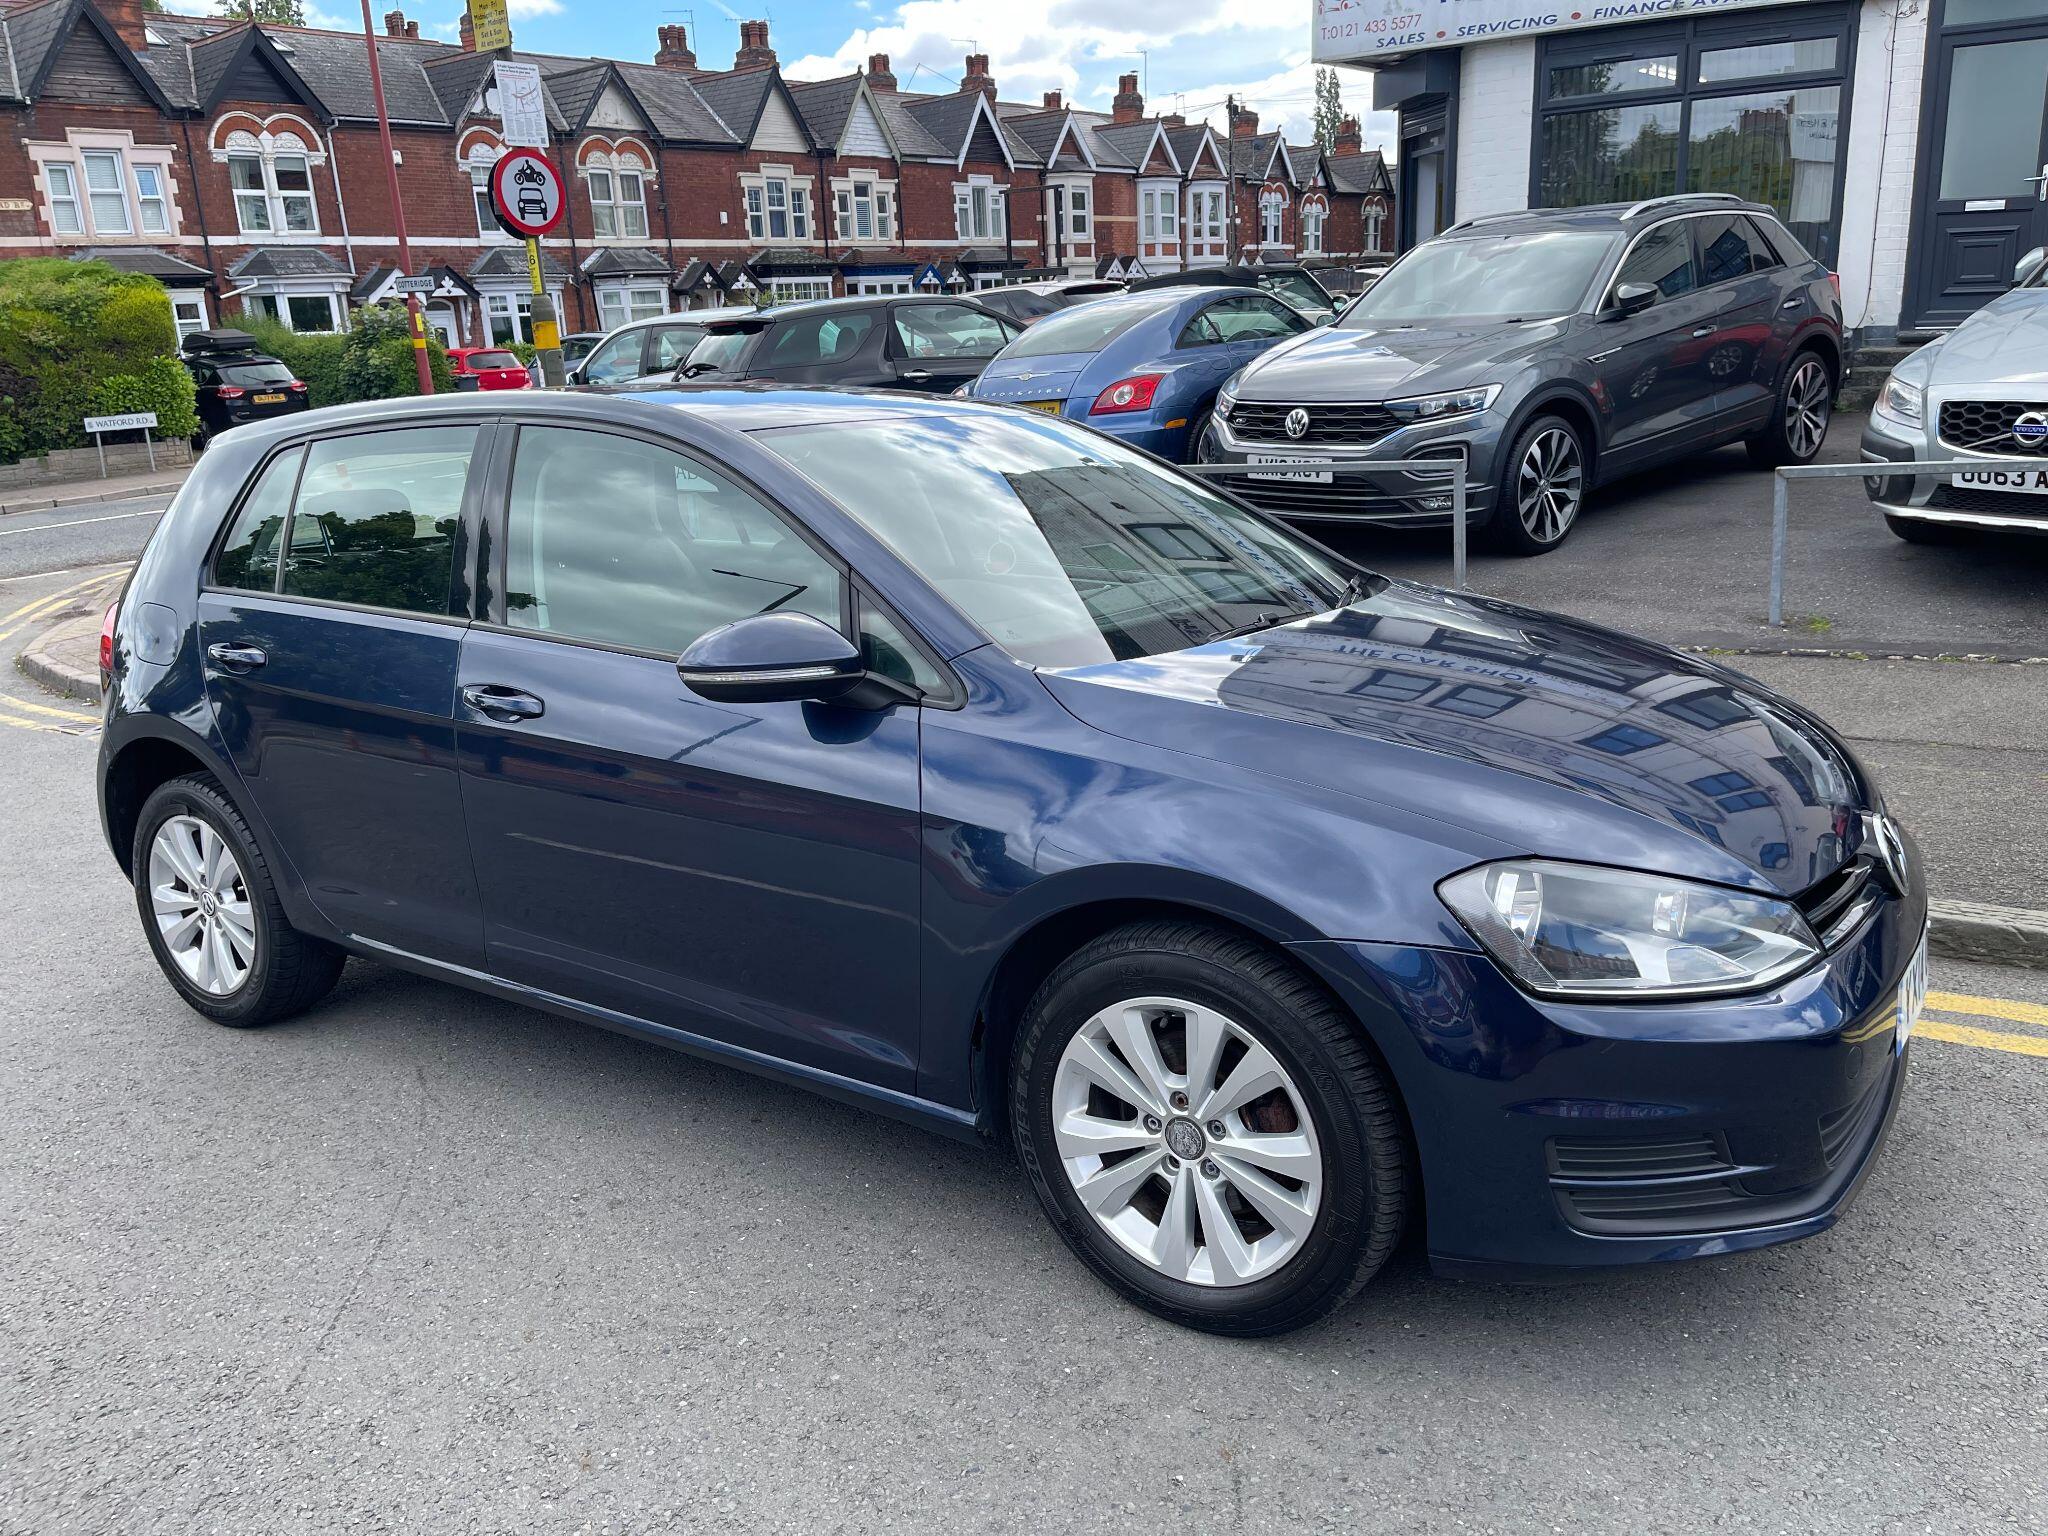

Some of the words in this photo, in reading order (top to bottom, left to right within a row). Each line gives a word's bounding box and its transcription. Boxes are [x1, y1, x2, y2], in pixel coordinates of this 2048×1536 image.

[1321, 22, 1359, 40] T:0121
[1364, 18, 1387, 34] 433
[1391, 14, 1422, 31] 5577
[1376, 32, 1426, 48] SALES
[1457, 14, 1558, 37] SERVICING
[1593, 0, 1684, 19] FINANCE
[398, 279, 433, 289] COTTERIDGE
[983, 387, 1062, 398] CROSSFIRE
[95, 418, 134, 428] WATFORD
[2015, 425, 2046, 433] VOLVO
